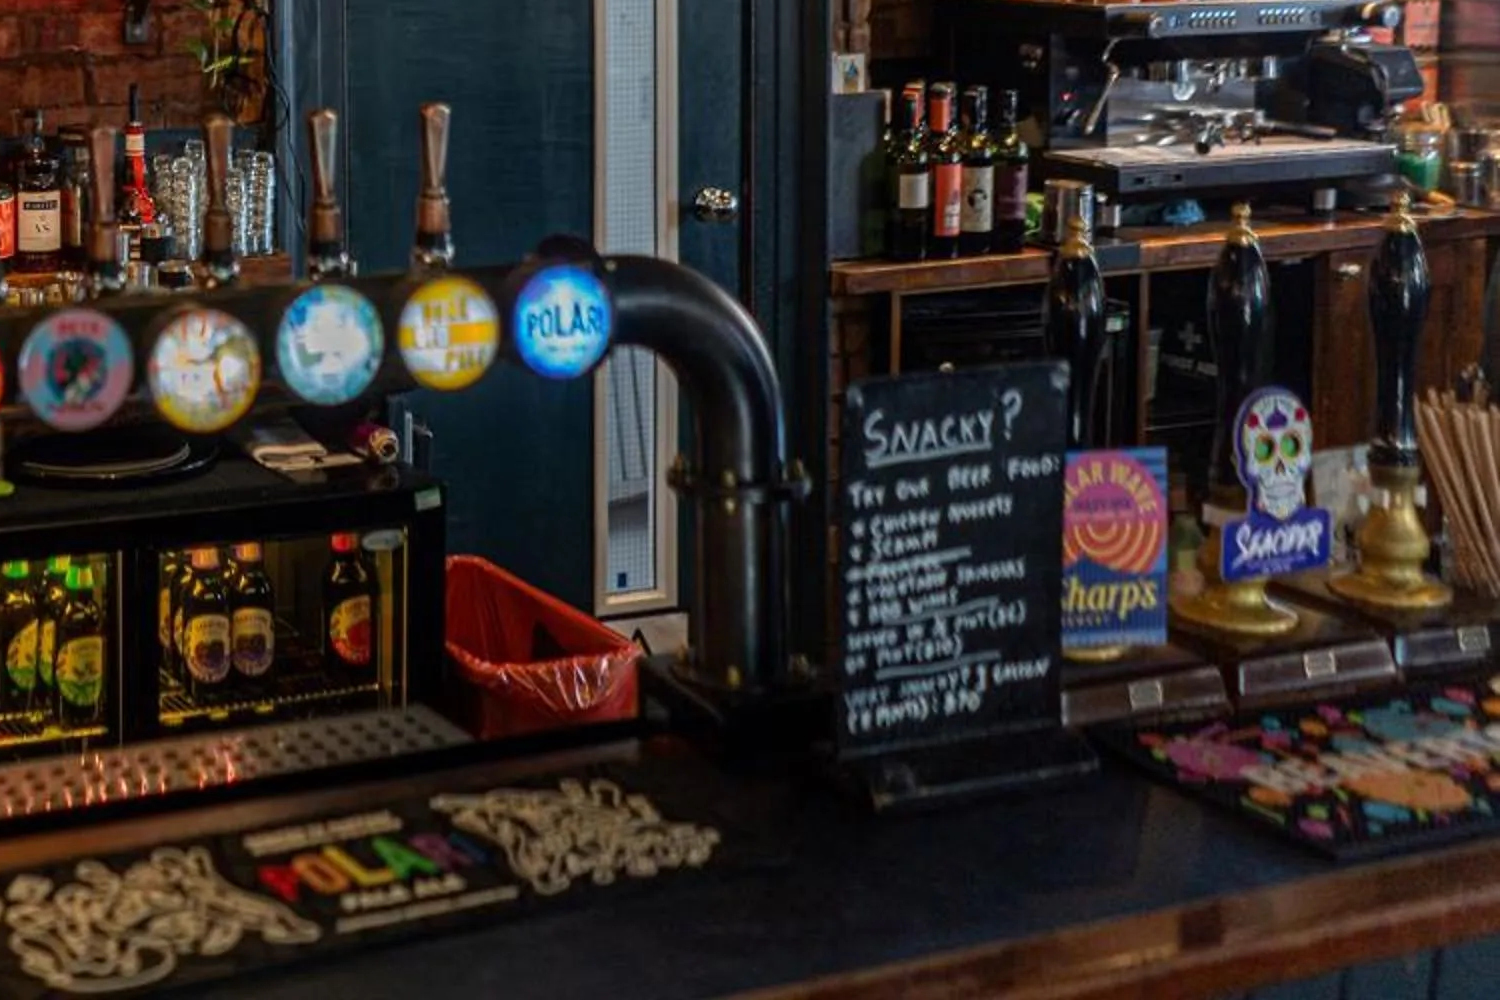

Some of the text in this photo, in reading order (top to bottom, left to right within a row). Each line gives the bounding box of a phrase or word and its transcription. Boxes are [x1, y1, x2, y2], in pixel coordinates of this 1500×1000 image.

[863, 389, 1022, 454] SNACKY?
[848, 480, 886, 509] TRY
[896, 476, 930, 501] OUR
[948, 463, 992, 490] BEER
